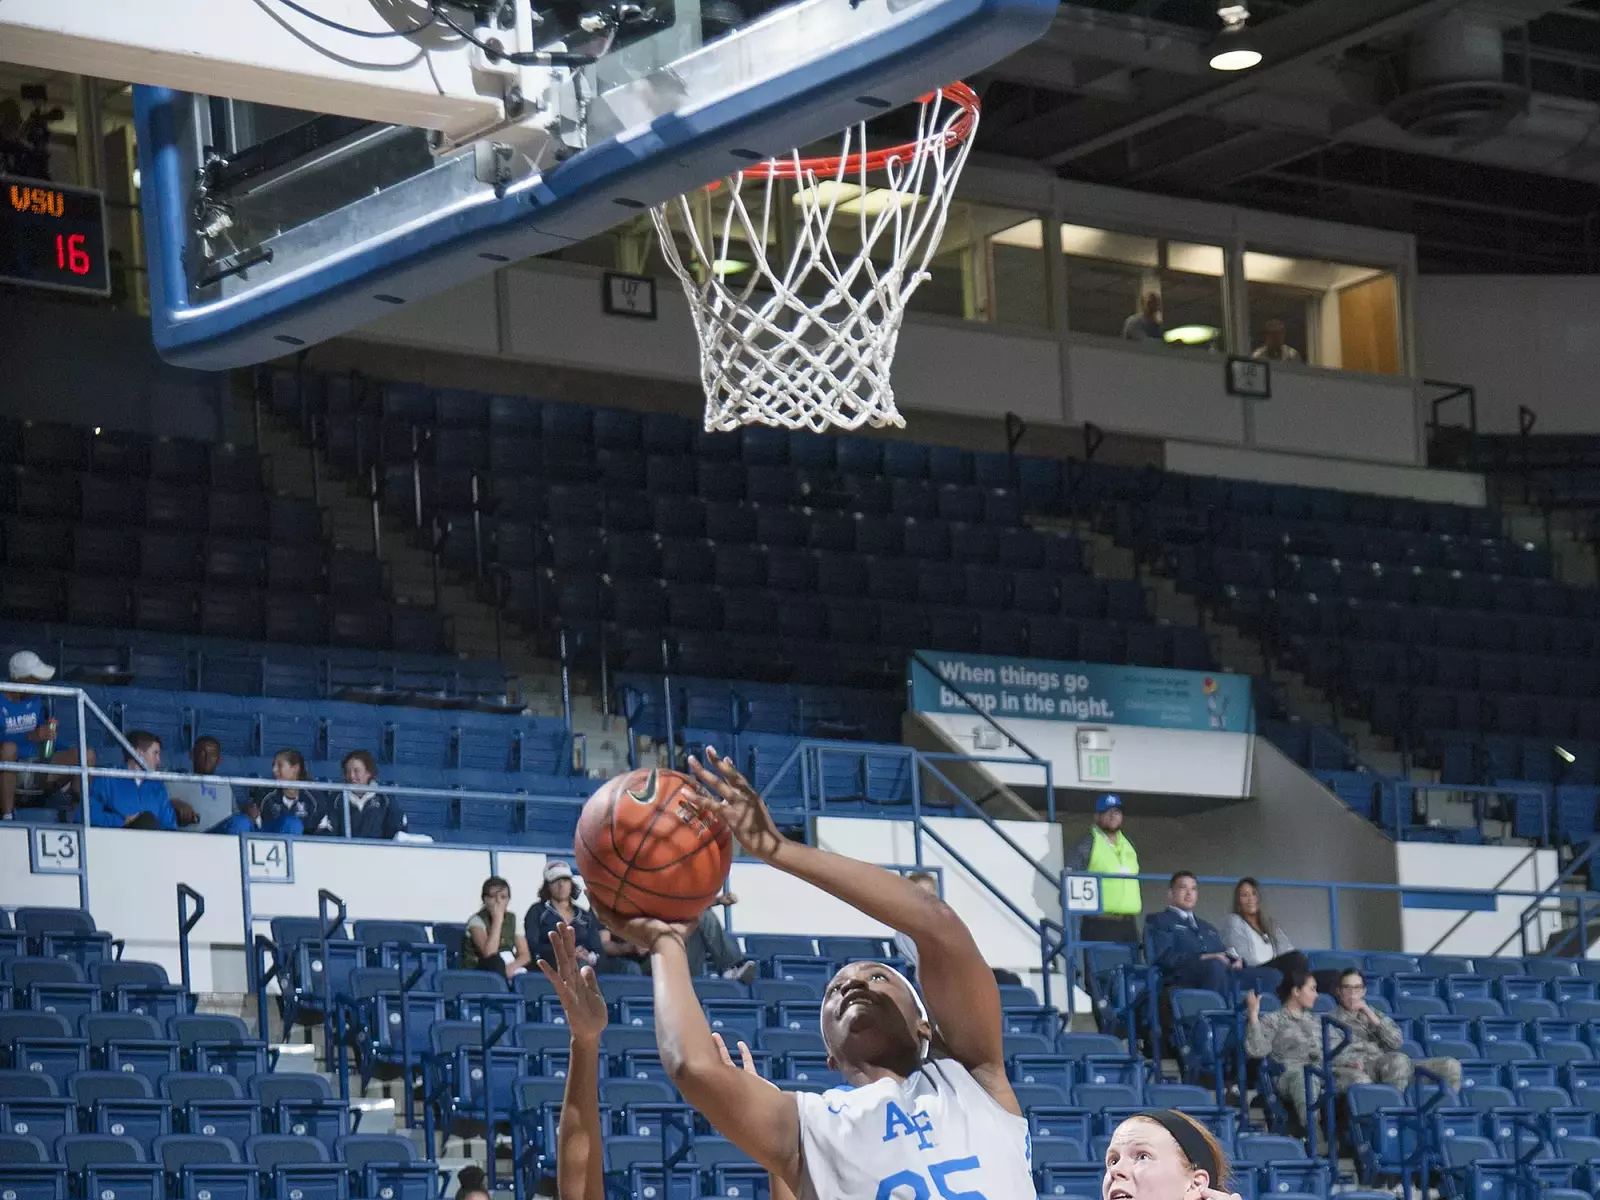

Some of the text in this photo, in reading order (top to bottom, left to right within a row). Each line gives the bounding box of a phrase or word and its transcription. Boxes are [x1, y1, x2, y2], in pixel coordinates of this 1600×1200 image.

[10, 185, 64, 217] WSU
[56, 233, 90, 275] 16
[937, 660, 1090, 694] When things go
[939, 685, 997, 712] bump
[1002, 689, 1019, 711] in
[1024, 692, 1056, 713] the
[1060, 695, 1115, 719] night.
[41, 833, 74, 859] L3
[251, 841, 281, 867] L4
[1070, 880, 1094, 901] L5
